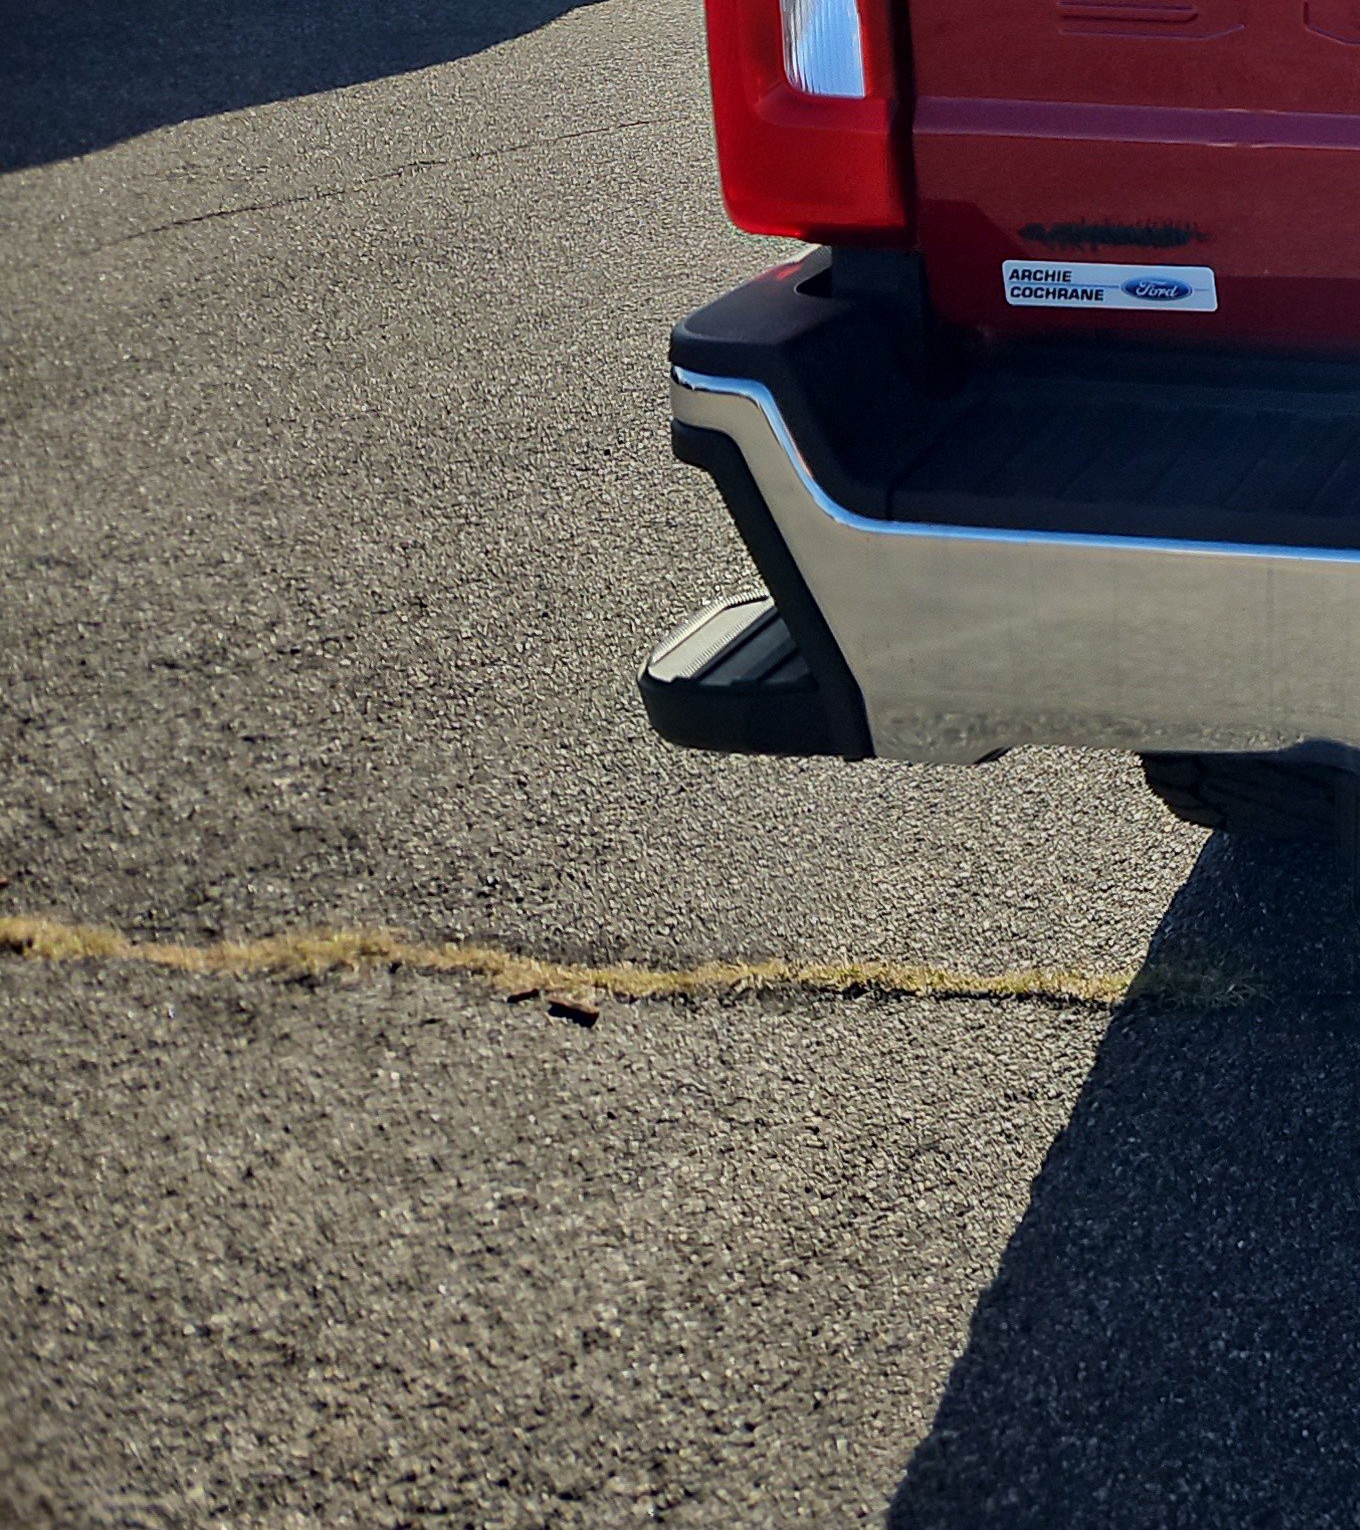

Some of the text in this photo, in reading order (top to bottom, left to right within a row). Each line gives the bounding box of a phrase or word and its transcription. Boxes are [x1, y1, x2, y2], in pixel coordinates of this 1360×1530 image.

[1008, 268, 1073, 283] ARCHIE
[1010, 285, 1105, 302] COCHRANE
[1135, 280, 1178, 299] Ford
